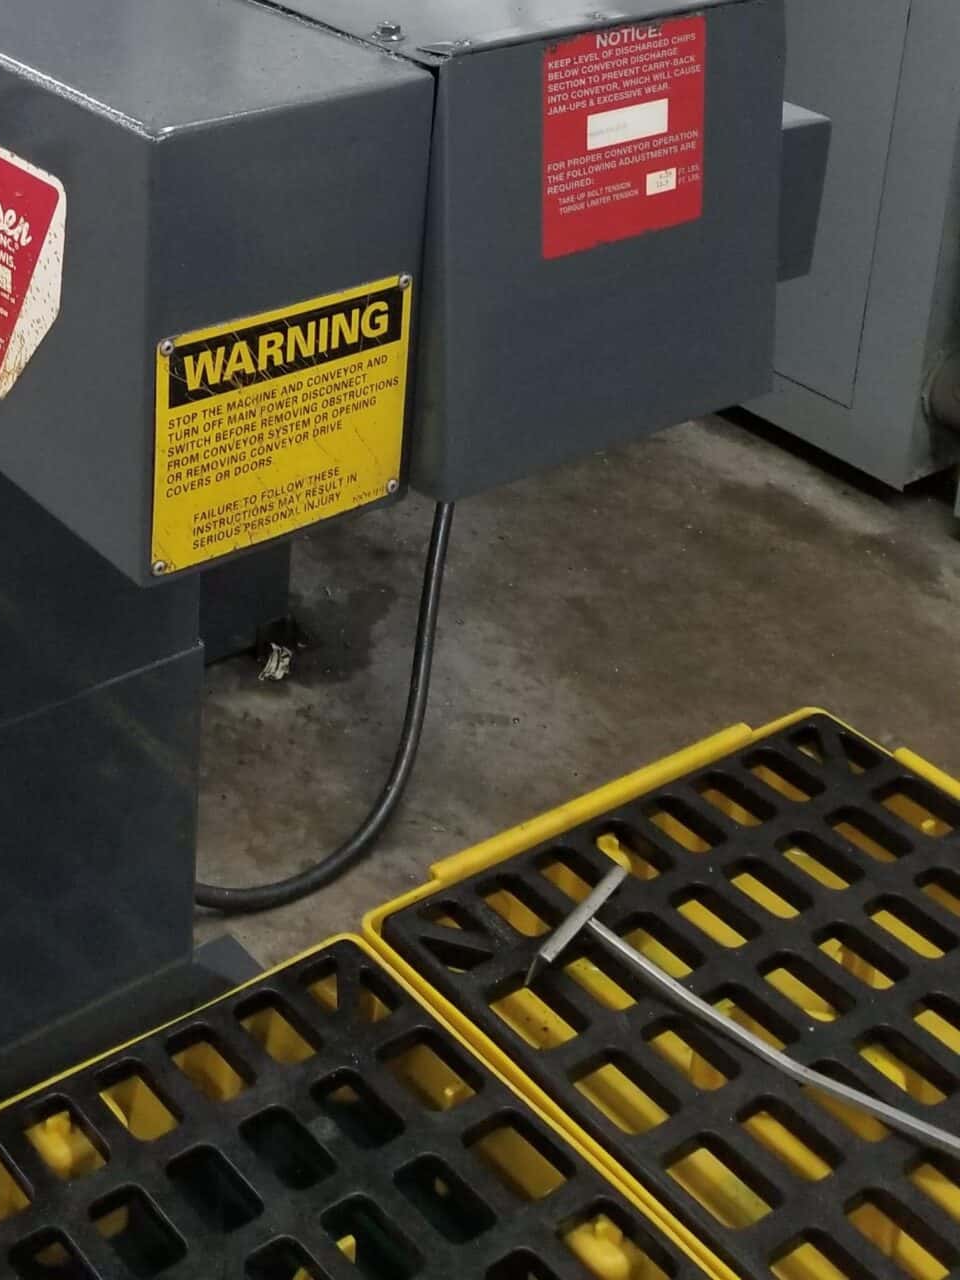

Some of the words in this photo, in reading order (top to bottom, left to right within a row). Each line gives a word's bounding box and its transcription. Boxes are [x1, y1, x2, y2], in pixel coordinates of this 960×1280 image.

[547, 67, 578, 82] BELOW
[581, 57, 627, 75] CONVEYOR
[630, 46, 677, 64] DISCHARGE
[547, 77, 585, 93] SECTION
[588, 74, 598, 84] TO
[602, 65, 639, 81] PREVENT
[642, 53, 694, 73] CARRY-BACK
[548, 58, 570, 71] KEEP
[573, 52, 599, 66] LEVEL
[602, 49, 612, 59] OF
[615, 37, 668, 56] DISCHARGED
[671, 32, 695, 45] CHIPS
[547, 92, 568, 105] INTO
[623, 74, 649, 88] WHICH
[652, 69, 671, 82] WILL
[674, 62, 700, 77] CAUSE
[548, 100, 586, 116] JAM-UPS
[597, 87, 641, 105] EXCESSIVE
[547, 160, 564, 173] FOR
[567, 152, 601, 168] PROPER
[604, 140, 650, 159] CONVEYOR
[653, 128, 697, 147] OPERATION
[547, 172, 563, 184] THE
[566, 159, 615, 180] FOLLOWING
[619, 145, 677, 167] ADJUSTMENTS
[680, 140, 696, 152] ARE
[183, 300, 389, 391] WARNING
[167, 435, 210, 457] SWITCH
[215, 421, 256, 442] BEFORE
[261, 402, 317, 427] REMOVING
[321, 376, 398, 408] OBSTRUCTIONS
[168, 412, 197, 430] STOP
[202, 405, 222, 419] THE
[227, 388, 276, 412] MACHINE
[281, 380, 302, 395] AND
[307, 362, 362, 387] CONVEYOR
[367, 354, 387, 369] AND
[168, 425, 198, 443] TURN
[203, 418, 223, 432] OFF
[227, 407, 256, 425] MAIN
[260, 394, 298, 415] POWER
[302, 372, 367, 401] DISCONNECT
[167, 452, 199, 471] FROM
[203, 431, 264, 459] CONVEYOR
[268, 417, 310, 439] SYSTEM
[314, 411, 328, 424] OR
[331, 396, 376, 419] OPENING
[167, 471, 182, 484] OR
[186, 451, 246, 478] REMOVING
[250, 431, 308, 458] CONVEYOR
[312, 420, 342, 438] DRIVE
[166, 475, 210, 498] COVERS
[215, 469, 230, 482] OR
[235, 456, 272, 476] DOORS
[193, 499, 239, 522] FAILURE
[242, 494, 256, 506] TO
[261, 478, 303, 500] FOLLOW
[308, 466, 339, 484] THESE
[193, 500, 273, 536] INSTRUCTIONS
[278, 491, 300, 507] MAY
[304, 477, 342, 498] RESULT
[346, 472, 357, 484] IN
[193, 525, 240, 550] SERIOUS
[244, 505, 300, 532] PERSONAL
[304, 492, 340, 512] INJURY
